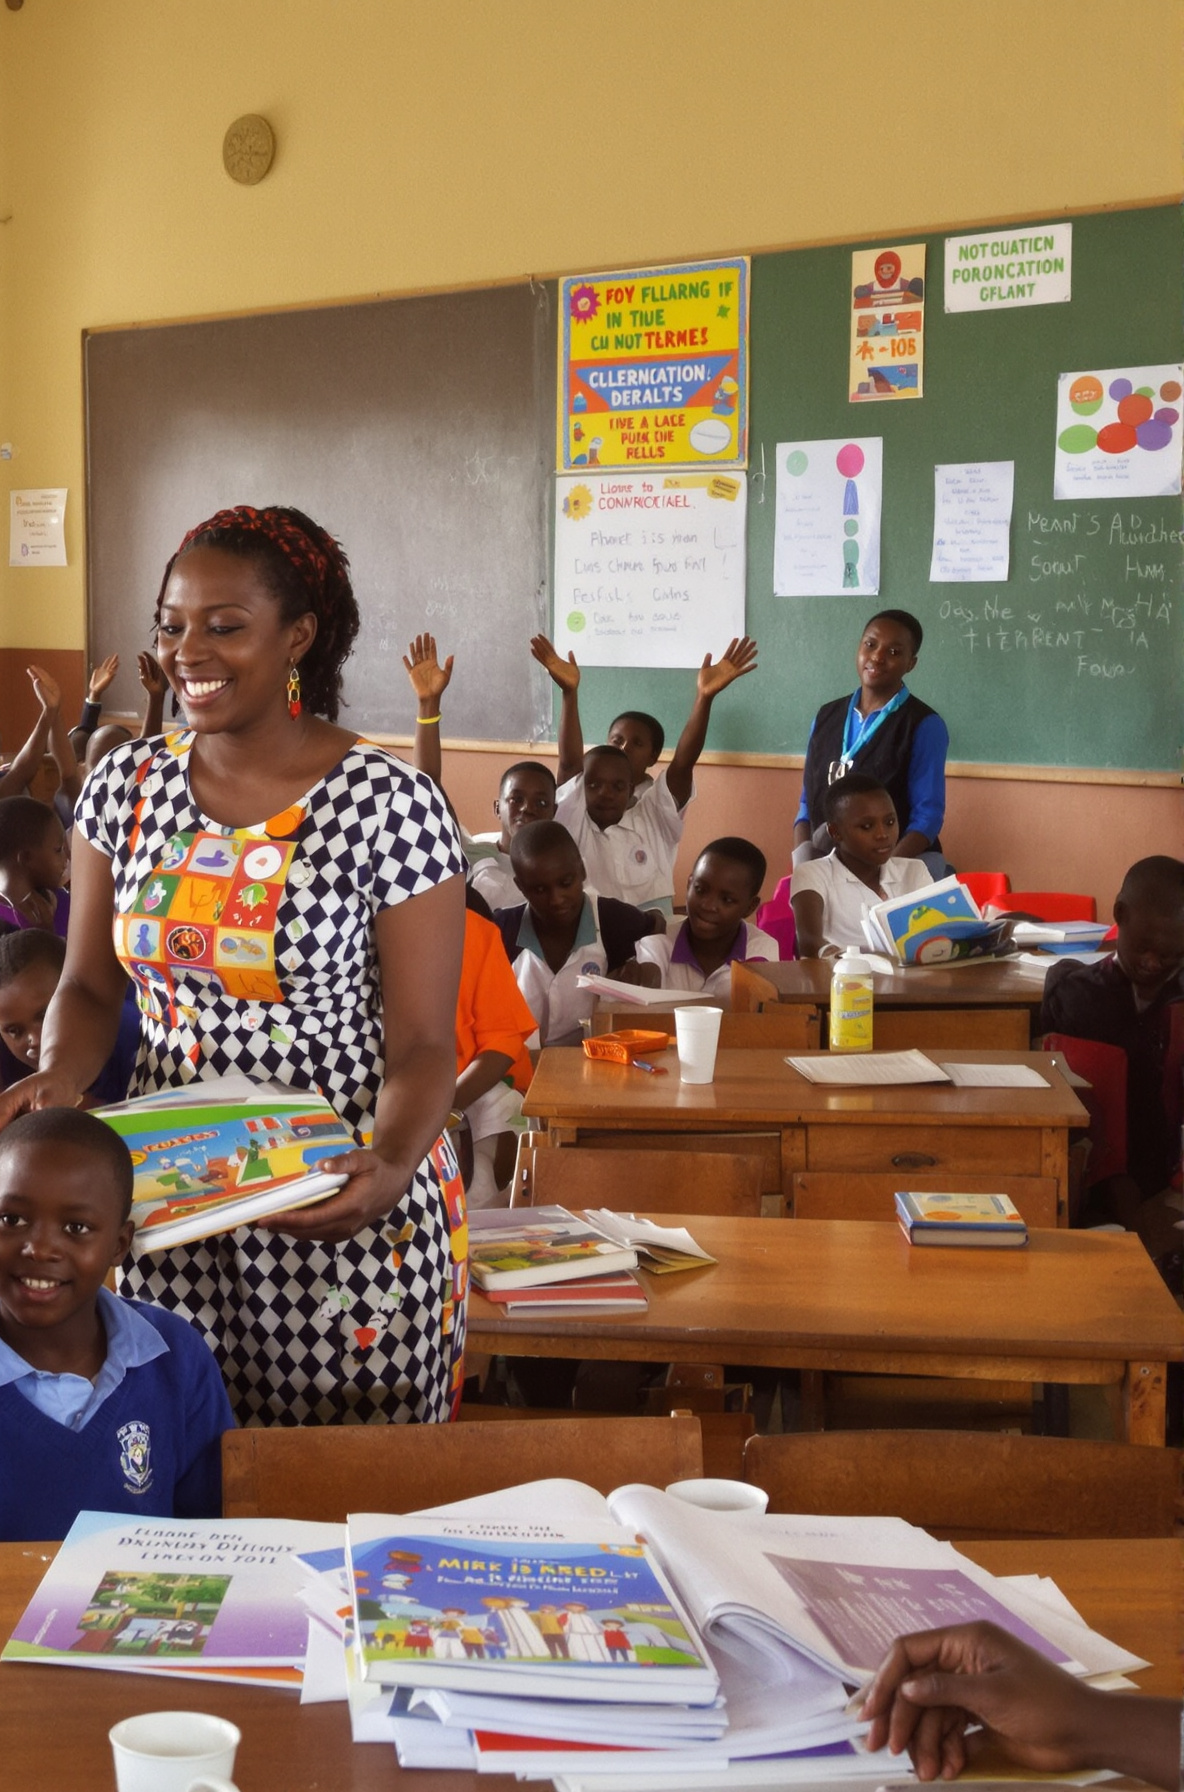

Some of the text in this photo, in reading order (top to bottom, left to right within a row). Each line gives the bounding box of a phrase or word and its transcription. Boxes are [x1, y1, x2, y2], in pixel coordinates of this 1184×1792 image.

[952, 257, 1065, 284] PORONCATION
[606, 285, 635, 305] FOY
[641, 280, 711, 304] FLLARNG
[606, 311, 622, 329] IN
[611, 386, 683, 407] DERALTS
[640, 415, 649, 429] A
[641, 481, 654, 493] to
